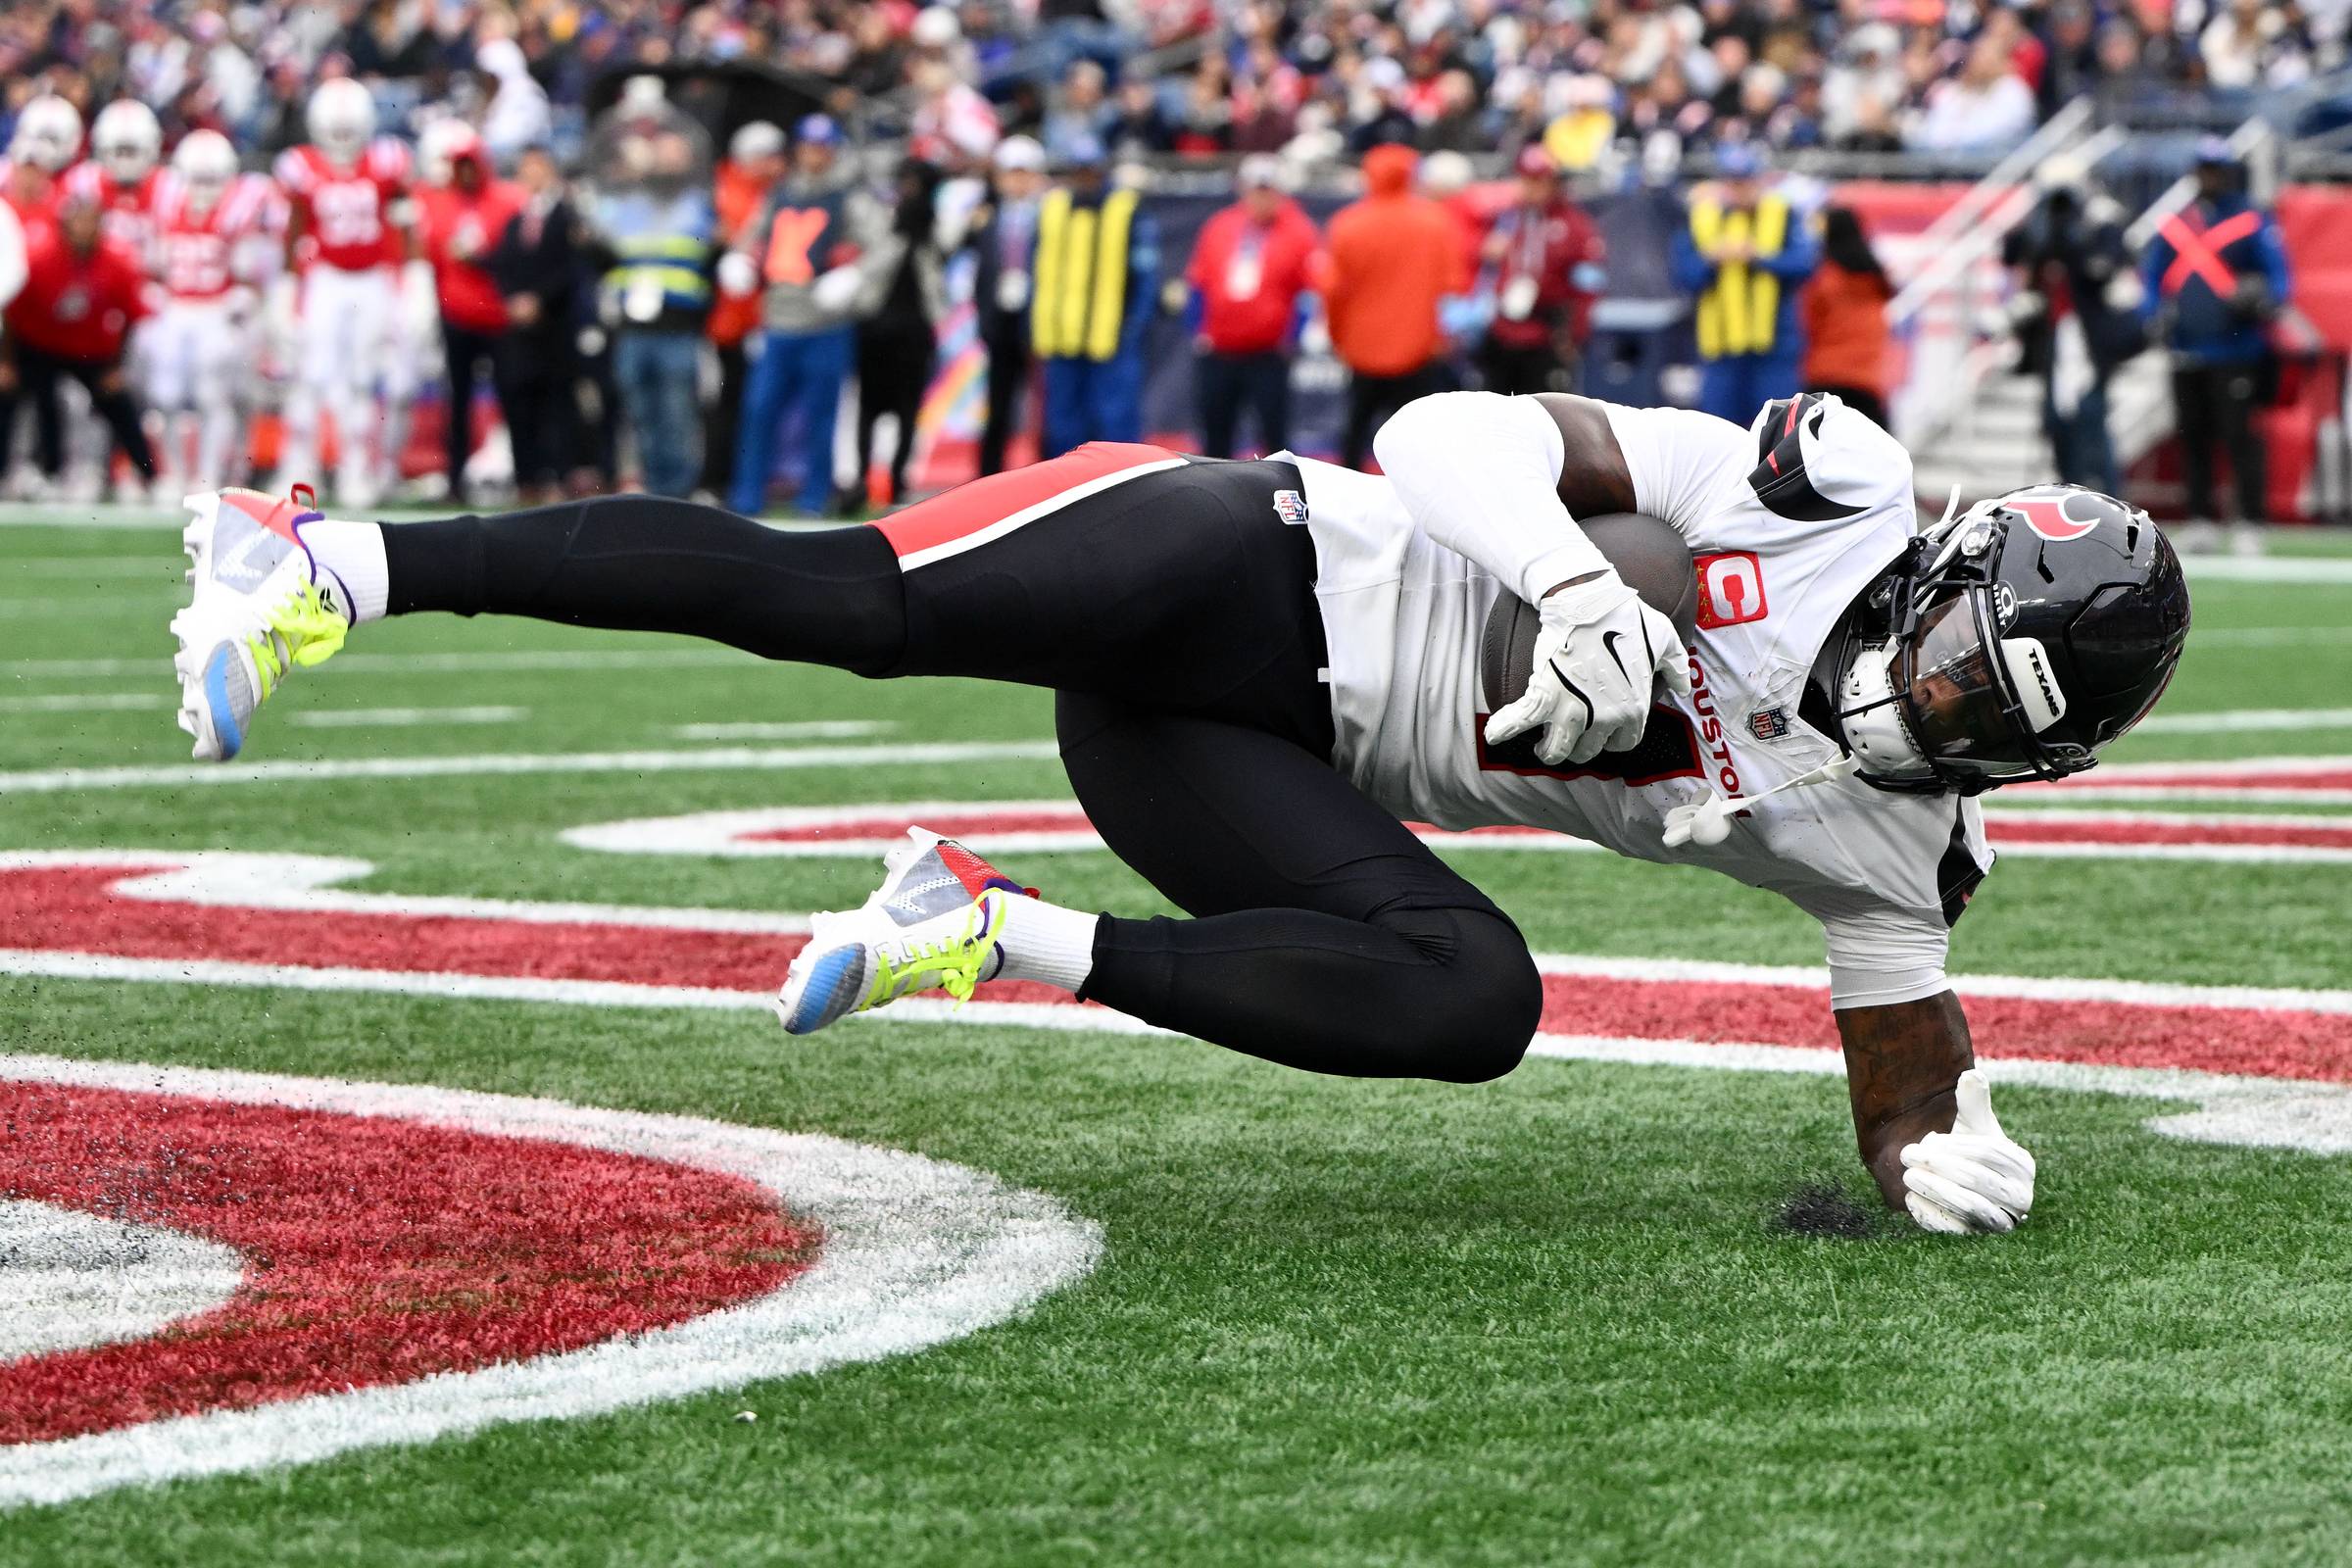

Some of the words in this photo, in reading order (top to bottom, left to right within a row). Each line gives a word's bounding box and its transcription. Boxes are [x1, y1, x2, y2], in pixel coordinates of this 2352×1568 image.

[1707, 557, 1760, 619] C
[1993, 584, 2007, 628] OAKLEY
[2029, 648, 2060, 717] TEXANS
[1754, 712, 1773, 737] NFL
